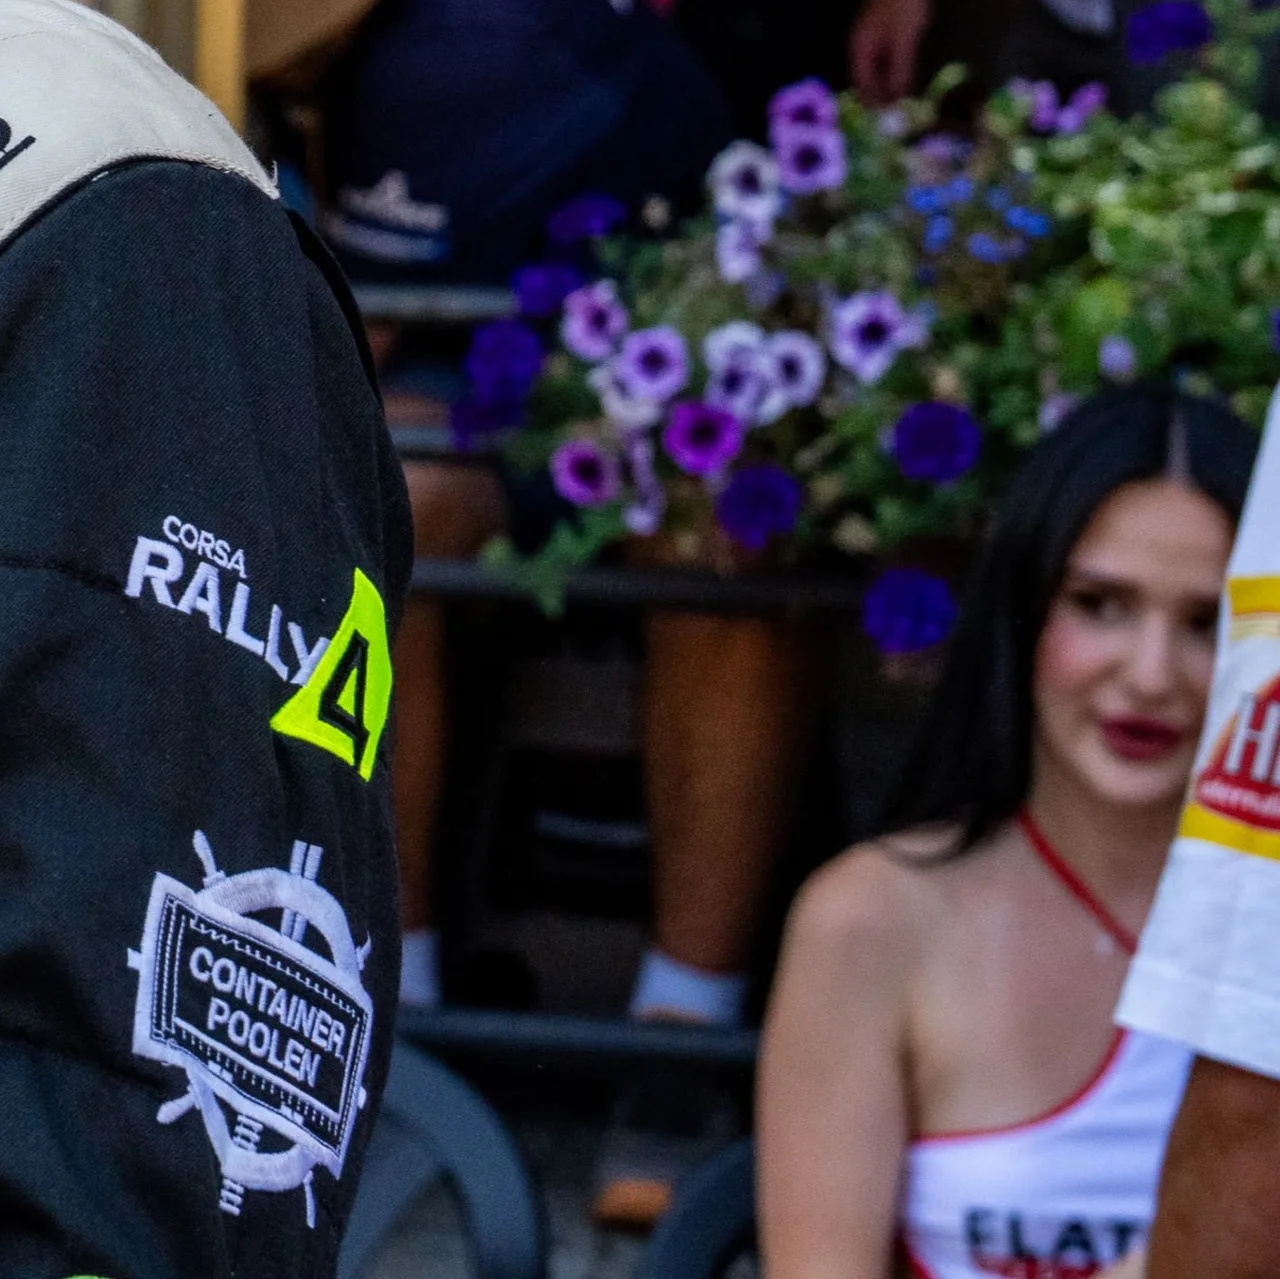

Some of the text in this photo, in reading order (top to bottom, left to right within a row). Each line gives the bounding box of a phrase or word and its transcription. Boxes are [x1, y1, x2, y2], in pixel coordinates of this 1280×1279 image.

[162, 515, 248, 581] CORSA
[124, 535, 332, 686] RALLY
[188, 945, 348, 1064] CONTAINER
[206, 996, 322, 1089] POOLEN
